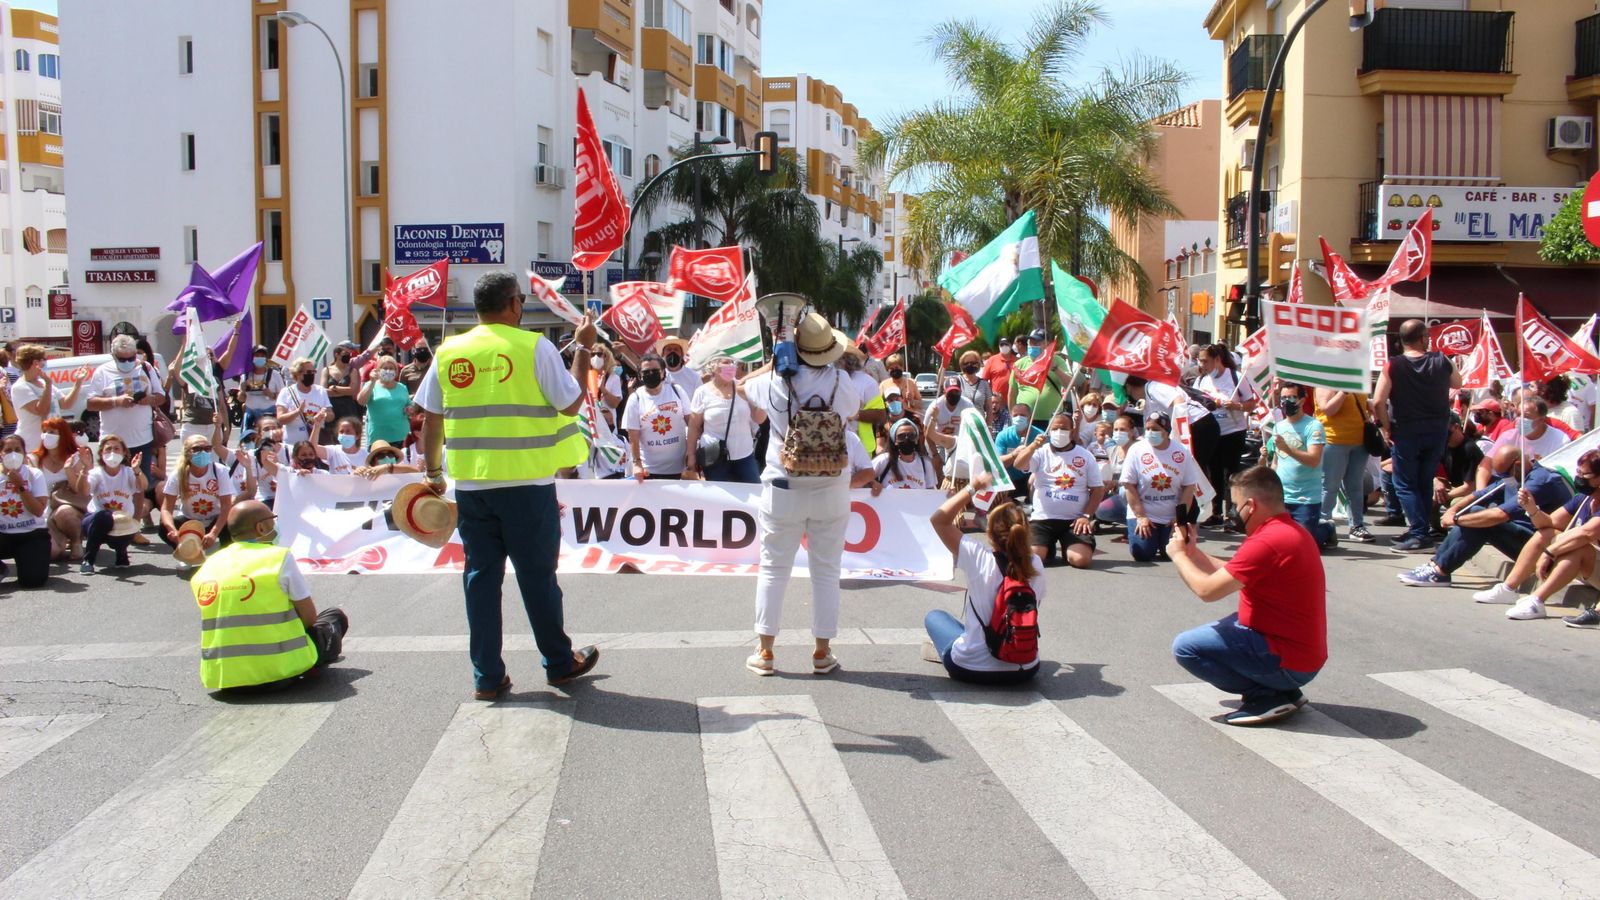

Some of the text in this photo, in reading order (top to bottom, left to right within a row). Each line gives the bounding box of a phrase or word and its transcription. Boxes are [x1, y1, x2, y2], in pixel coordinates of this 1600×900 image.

[1465, 188, 1570, 203] CAFÉ BAR SA
[1508, 213, 1557, 239] MA
[446, 240, 477, 250] Integral
[87, 271, 154, 282] TRAISA S.L.
[4, 308, 13, 323] P
[316, 301, 328, 318] P
[1274, 304, 1359, 334] CCOO
[1523, 320, 1571, 370] UGT
[572, 506, 757, 549] WORLD
